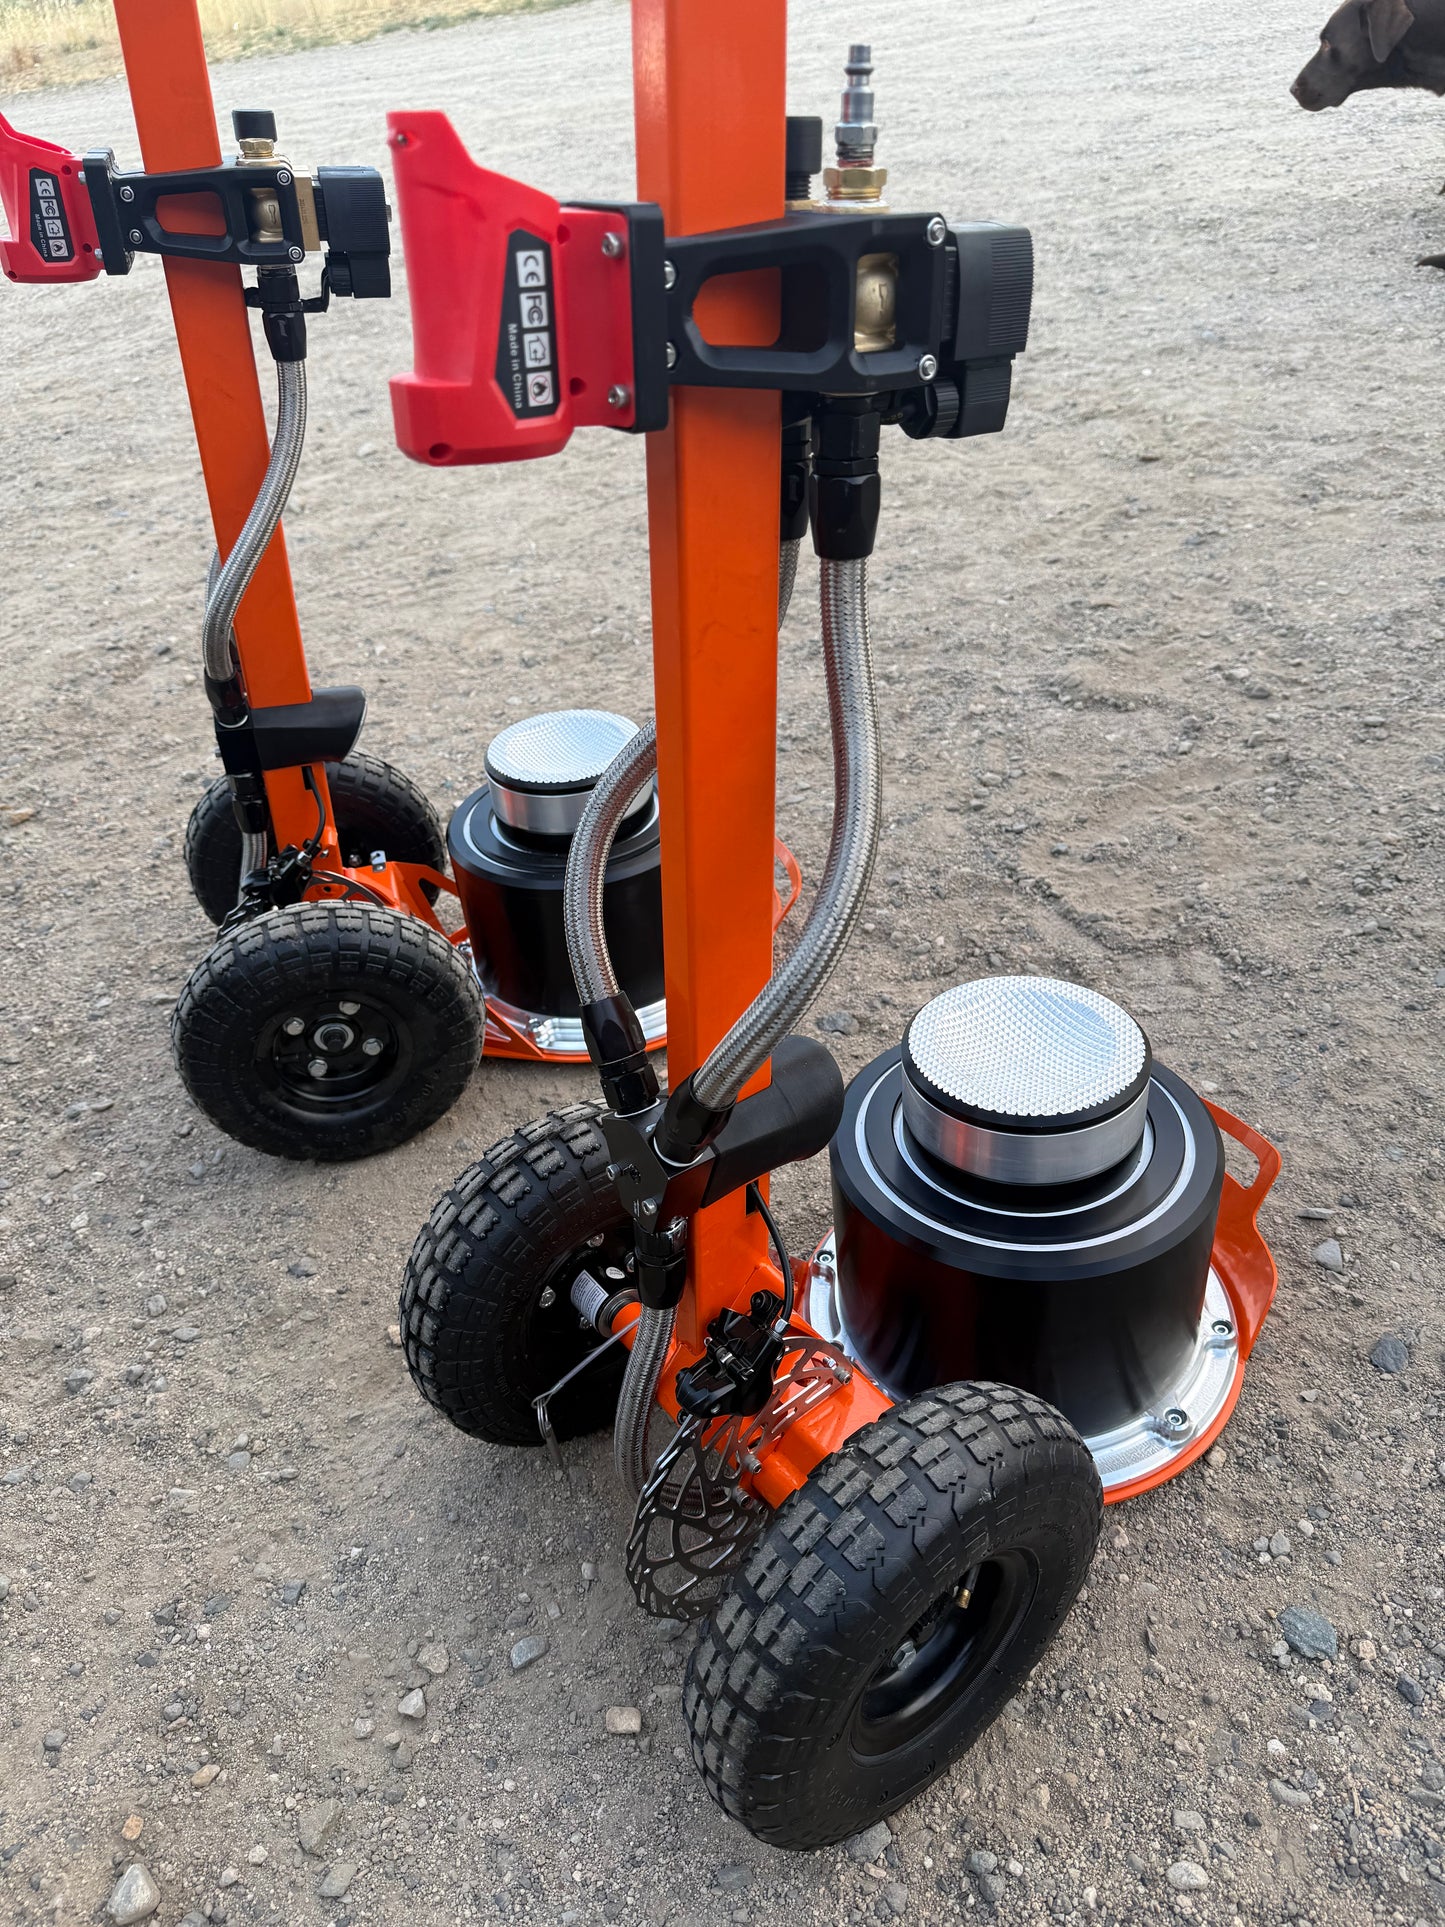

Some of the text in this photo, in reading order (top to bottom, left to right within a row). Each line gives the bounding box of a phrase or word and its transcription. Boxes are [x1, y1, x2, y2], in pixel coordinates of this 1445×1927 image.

[40, 181, 51, 195] CE
[523, 255, 541, 283] CE
[508, 323, 523, 409] Made in China
